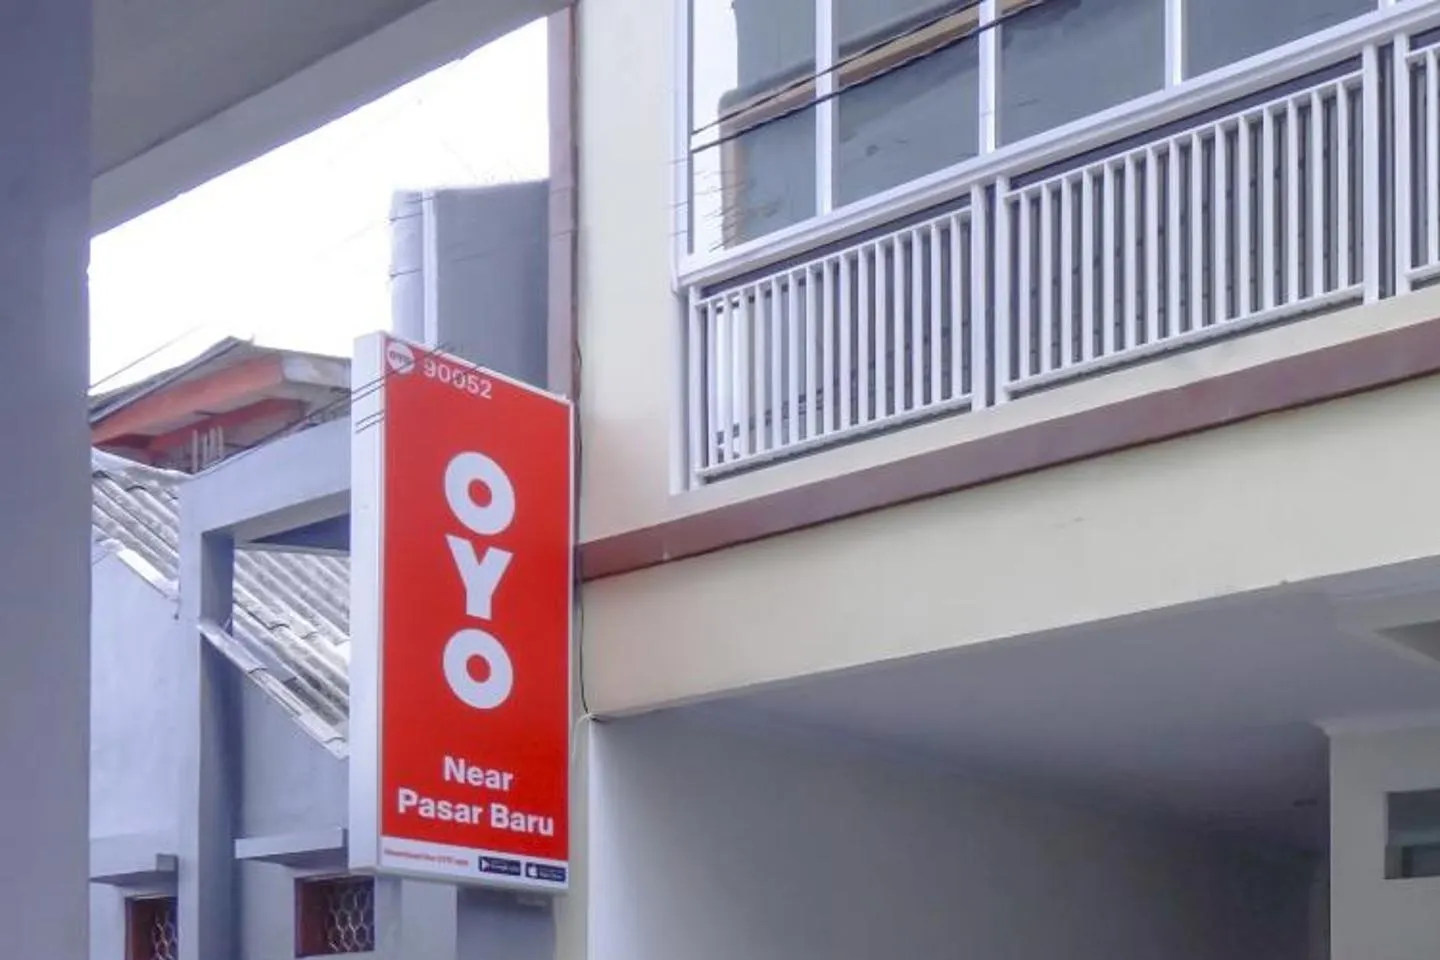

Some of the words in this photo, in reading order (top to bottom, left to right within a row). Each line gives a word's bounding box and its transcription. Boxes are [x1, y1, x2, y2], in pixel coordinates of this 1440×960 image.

[424, 358, 492, 399] 90052
[443, 452, 516, 709] OYO
[444, 756, 514, 791] Near
[398, 788, 483, 825] Pasar
[491, 803, 554, 836] Baru
